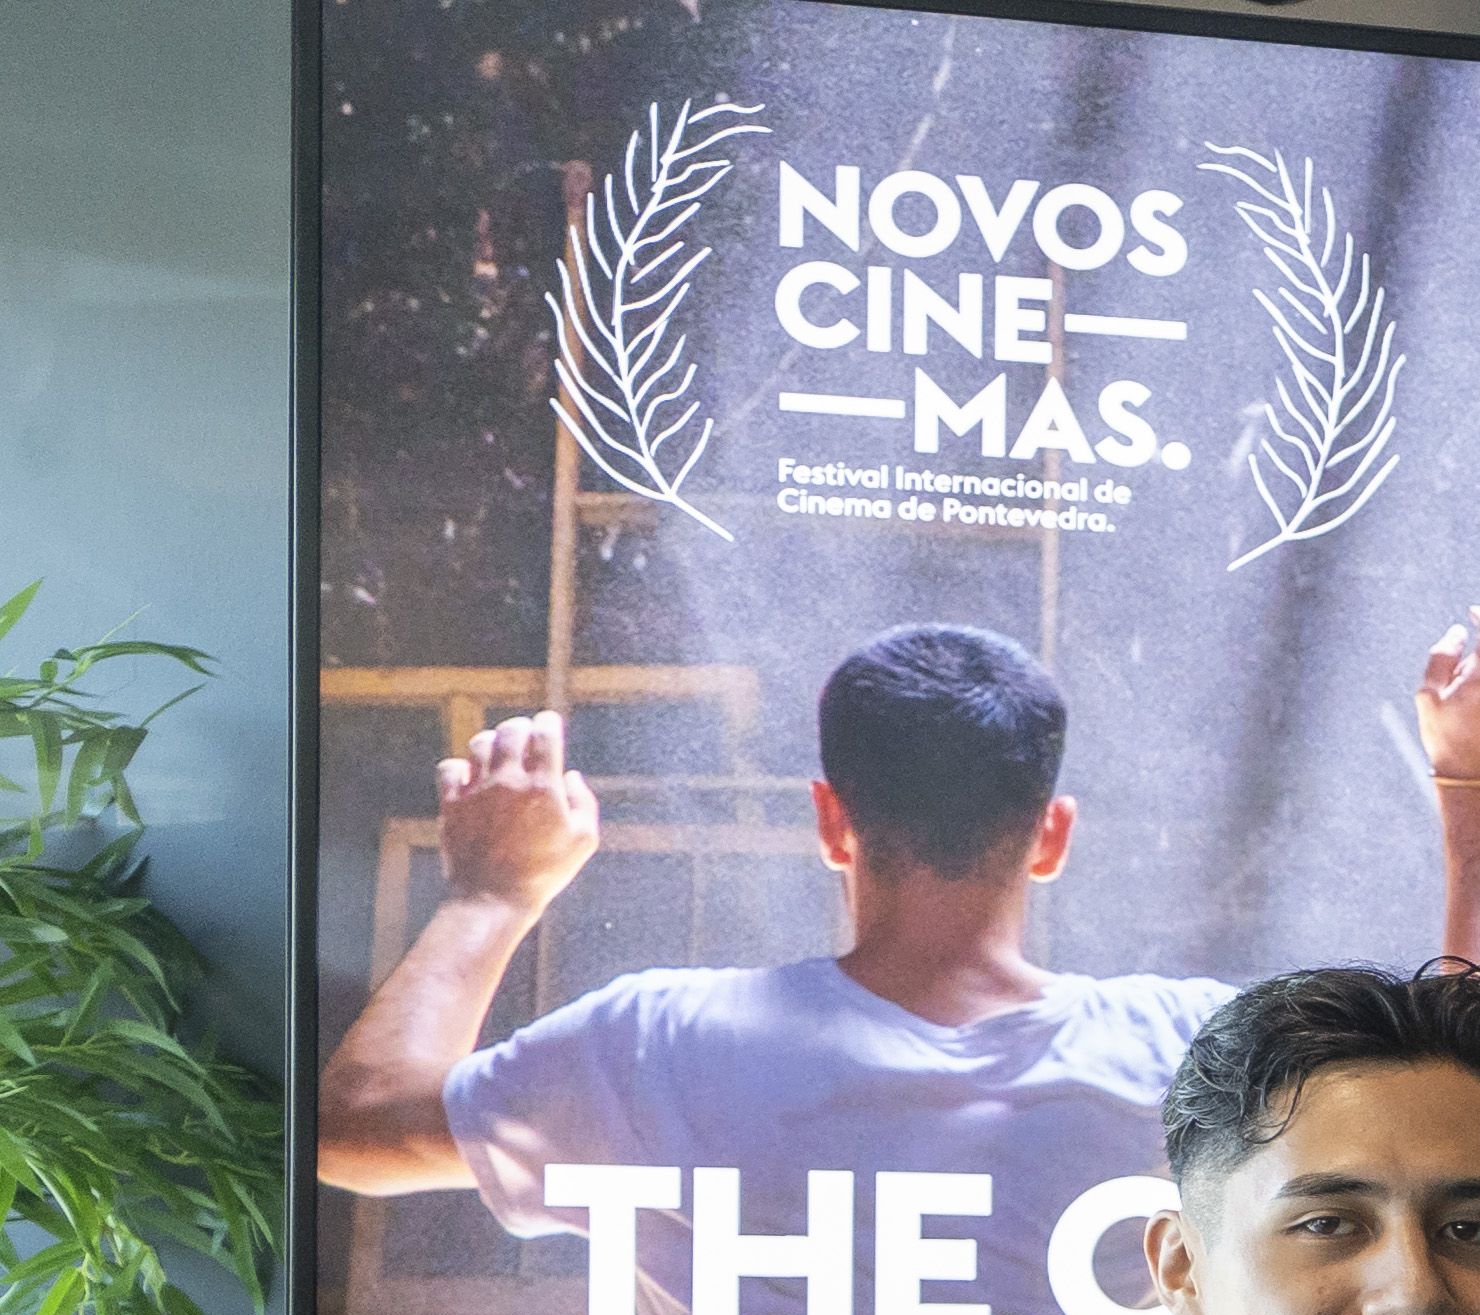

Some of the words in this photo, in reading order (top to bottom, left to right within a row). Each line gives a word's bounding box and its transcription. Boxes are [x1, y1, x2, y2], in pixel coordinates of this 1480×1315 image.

[778, 159, 1189, 277] NOVOS
[777, 456, 889, 489] Festival
[894, 464, 1089, 501] Internacional
[1093, 479, 1133, 505] de
[776, 487, 892, 520] Cinema
[896, 495, 937, 522] de
[942, 497, 1116, 533] Pontevedra.
